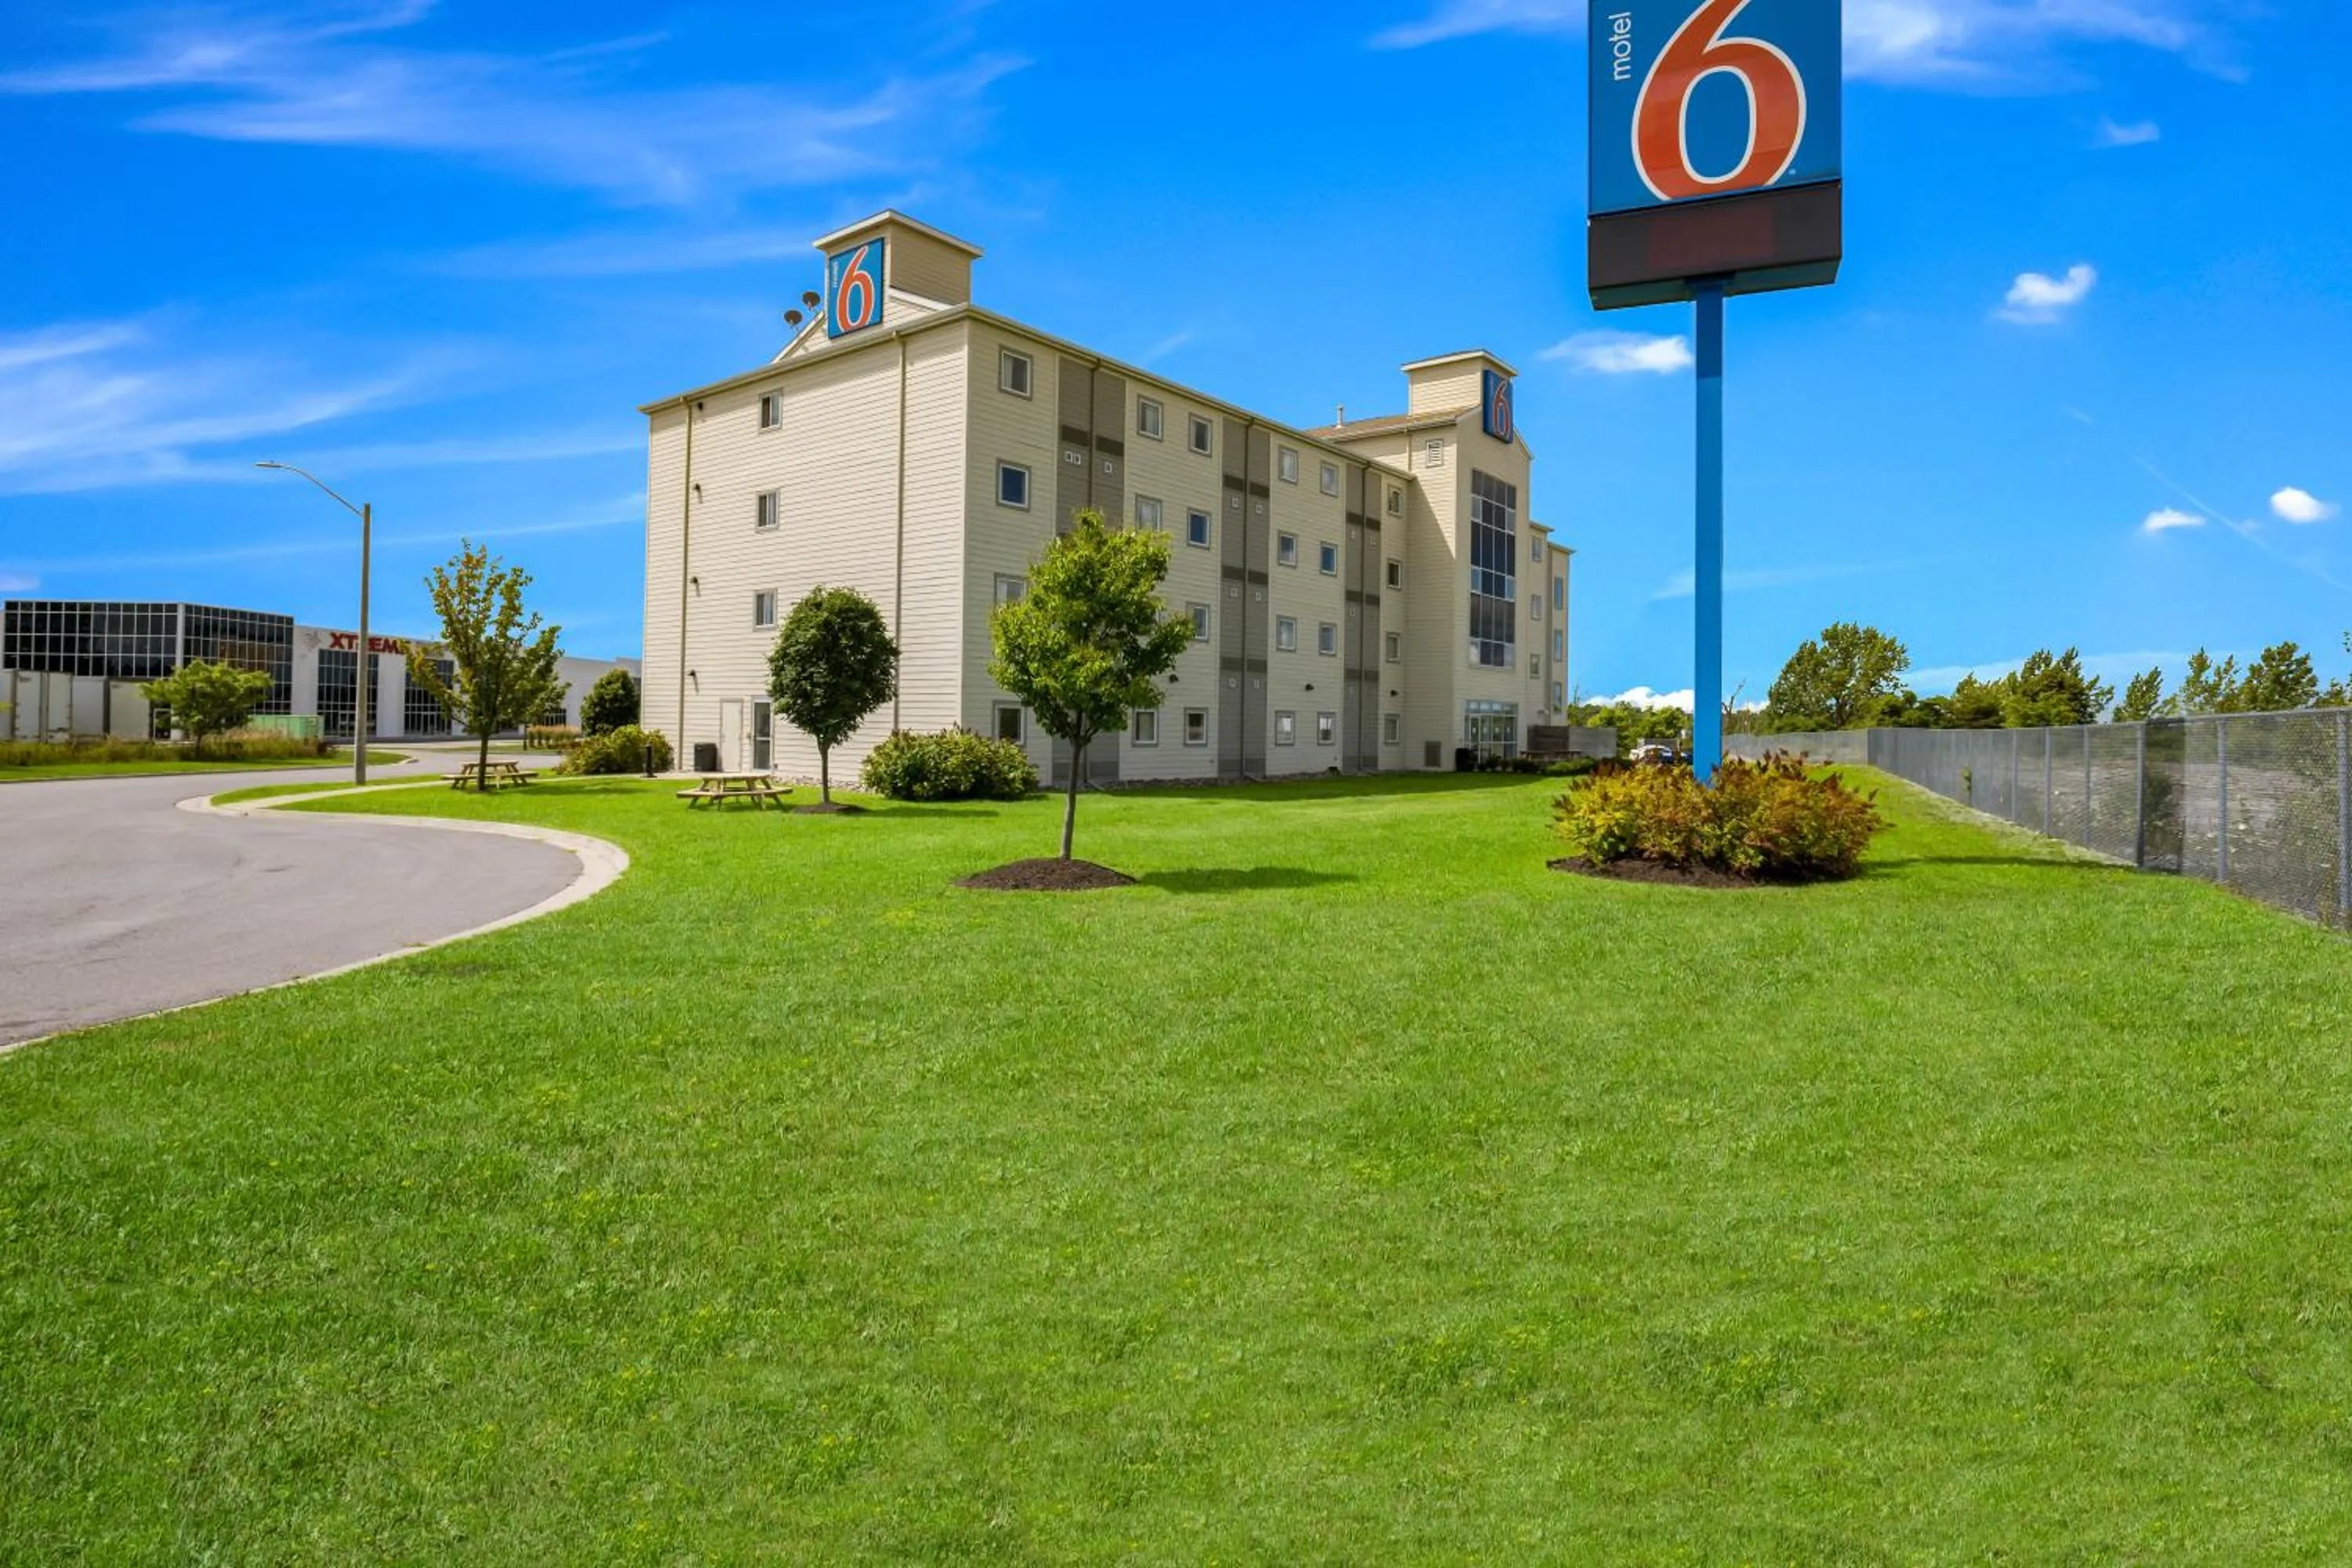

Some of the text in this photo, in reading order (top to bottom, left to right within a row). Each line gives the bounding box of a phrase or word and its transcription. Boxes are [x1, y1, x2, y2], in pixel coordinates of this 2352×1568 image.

[1608, 12, 1632, 81] motel
[1632, 0, 1806, 201] 6
[837, 245, 875, 332] 6
[1493, 379, 1511, 439] 6
[329, 632, 409, 655] XTEM
